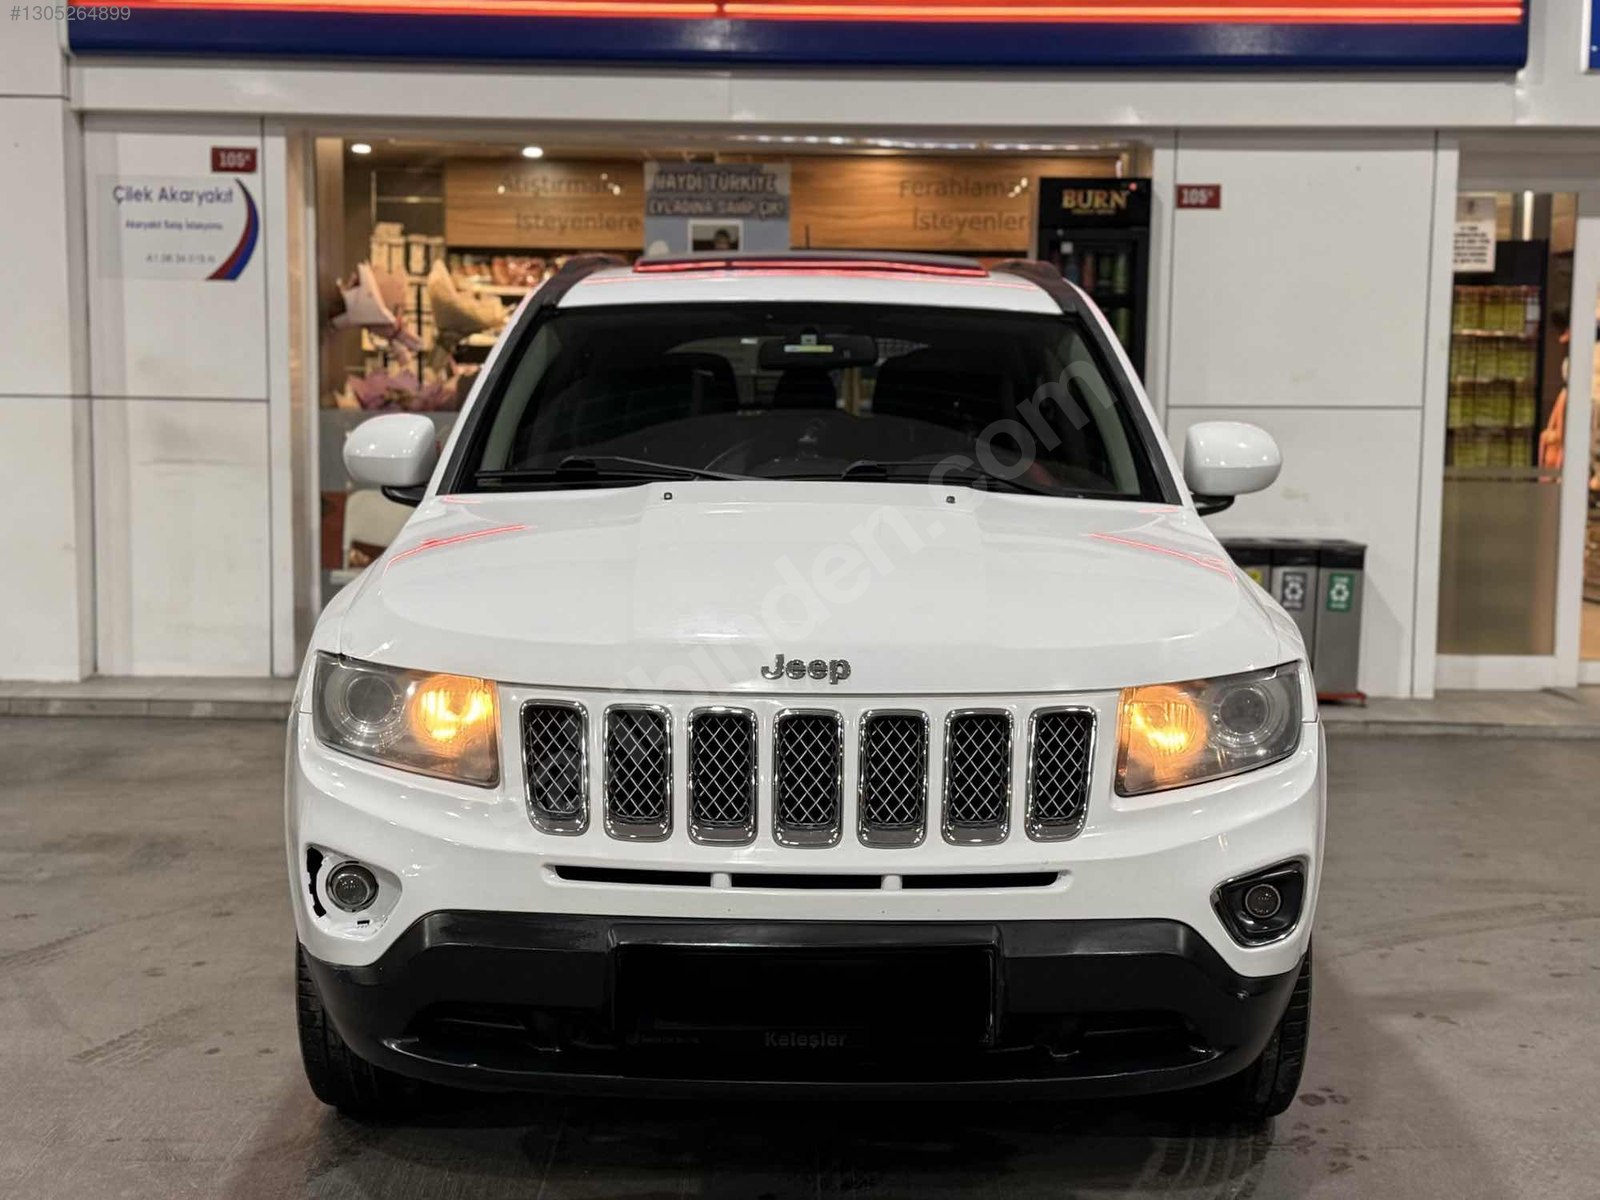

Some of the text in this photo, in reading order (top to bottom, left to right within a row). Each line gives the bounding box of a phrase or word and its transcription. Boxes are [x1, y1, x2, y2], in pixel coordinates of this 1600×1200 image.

[113, 185, 234, 206] Çilek Akaryakıt
[1062, 189, 1128, 209] BURN
[913, 206, 1031, 236] İsteyenler
[761, 653, 851, 685] Jeep
